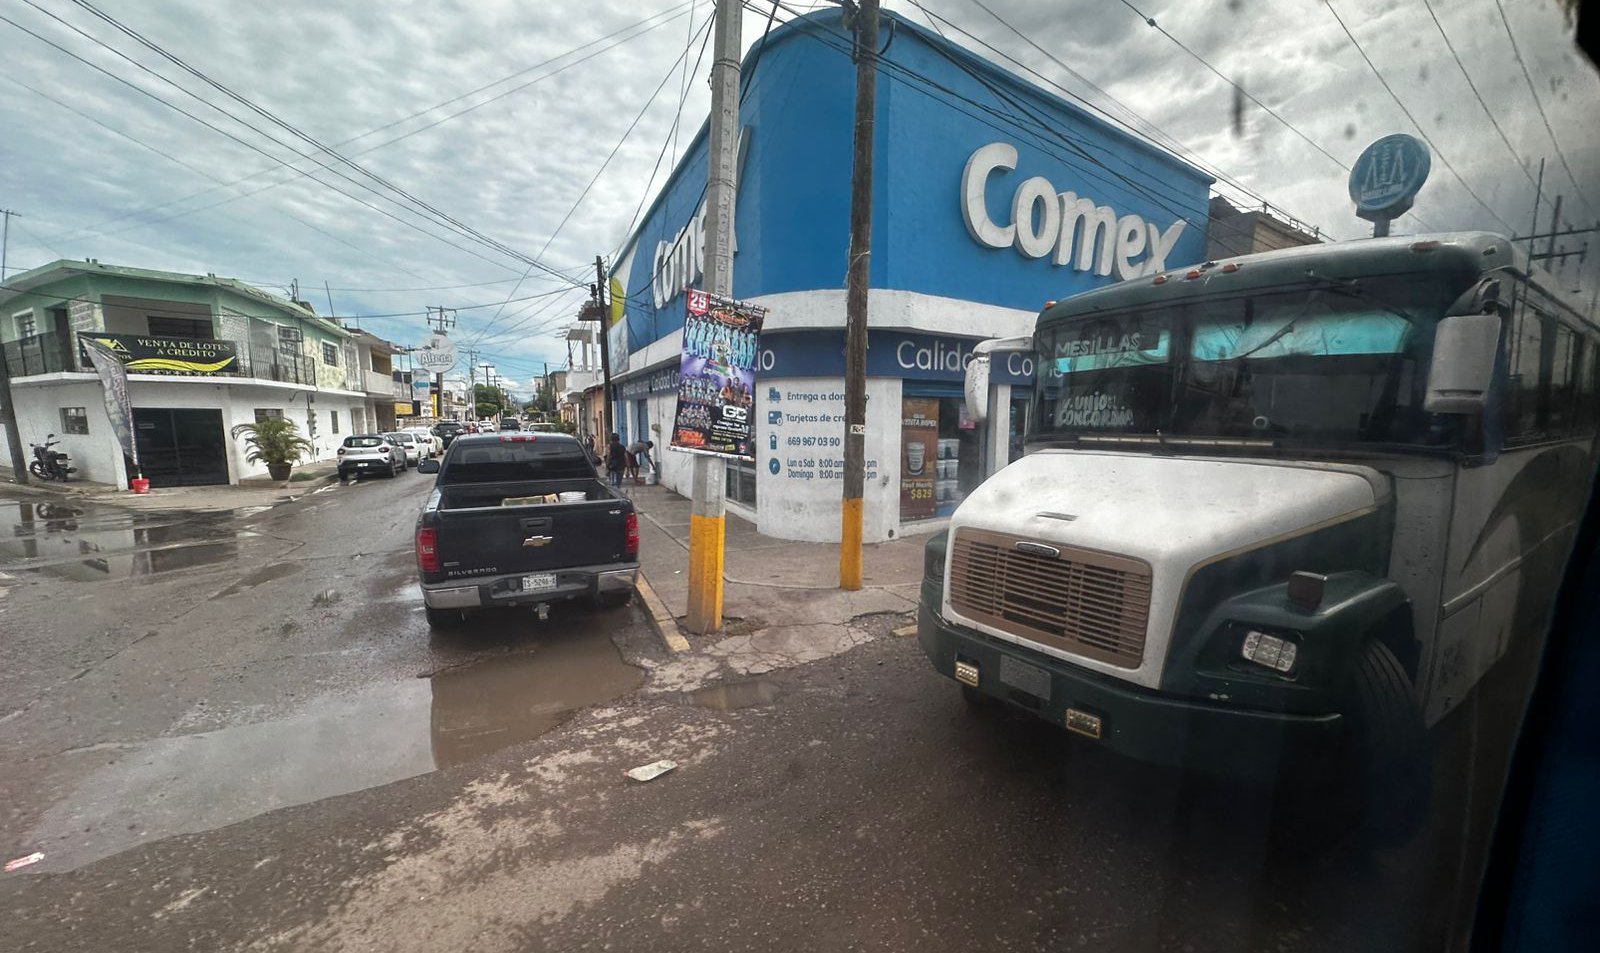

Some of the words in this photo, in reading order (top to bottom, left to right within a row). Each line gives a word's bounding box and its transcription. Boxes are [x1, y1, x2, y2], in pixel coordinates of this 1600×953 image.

[961, 142, 1190, 282] Comex
[138, 339, 177, 348] VENTA
[180, 341, 195, 349] DE
[197, 342, 230, 351] LOTES
[787, 392, 819, 402] Entrega
[786, 414, 818, 423] Tarjetas
[820, 414, 831, 422] de
[788, 437, 801, 446] 669
[802, 437, 816, 446] 967
[817, 437, 828, 446] 03
[829, 437, 841, 446] 90
[787, 458, 798, 467] Lun
[803, 458, 815, 468] Sab
[819, 459, 833, 468] 8:00
[867, 460, 877, 468] pm
[788, 469, 814, 480] Domingo
[819, 470, 833, 479] 8:00
[867, 471, 877, 480] pm
[911, 488, 932, 500] $829
[448, 567, 497, 576] SILVERADO
